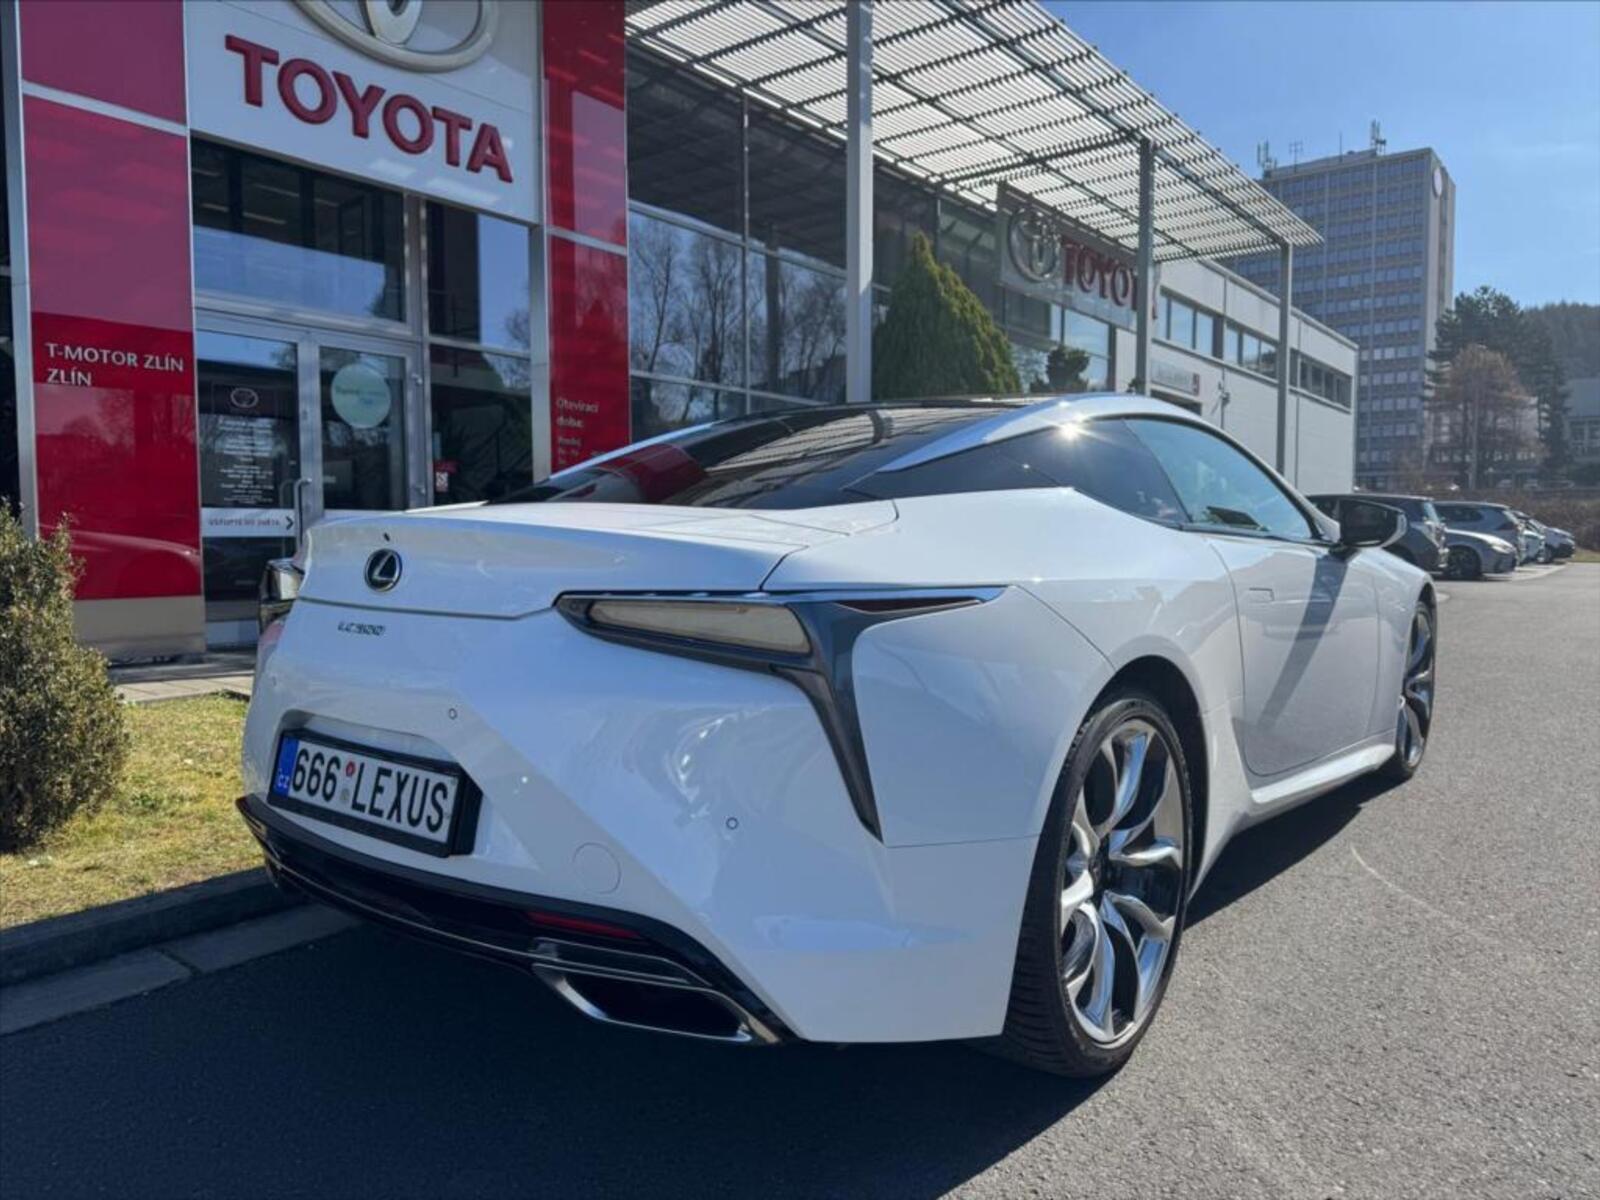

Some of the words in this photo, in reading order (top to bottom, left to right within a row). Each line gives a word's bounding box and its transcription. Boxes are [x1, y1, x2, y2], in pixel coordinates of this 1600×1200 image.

[225, 34, 513, 184] TOYOTA
[45, 342, 138, 367] T-MOTOR
[143, 353, 184, 373] ZLÍN
[46, 366, 92, 386] ZLÍN
[292, 748, 341, 802] 666
[351, 762, 448, 833] LEXUS
